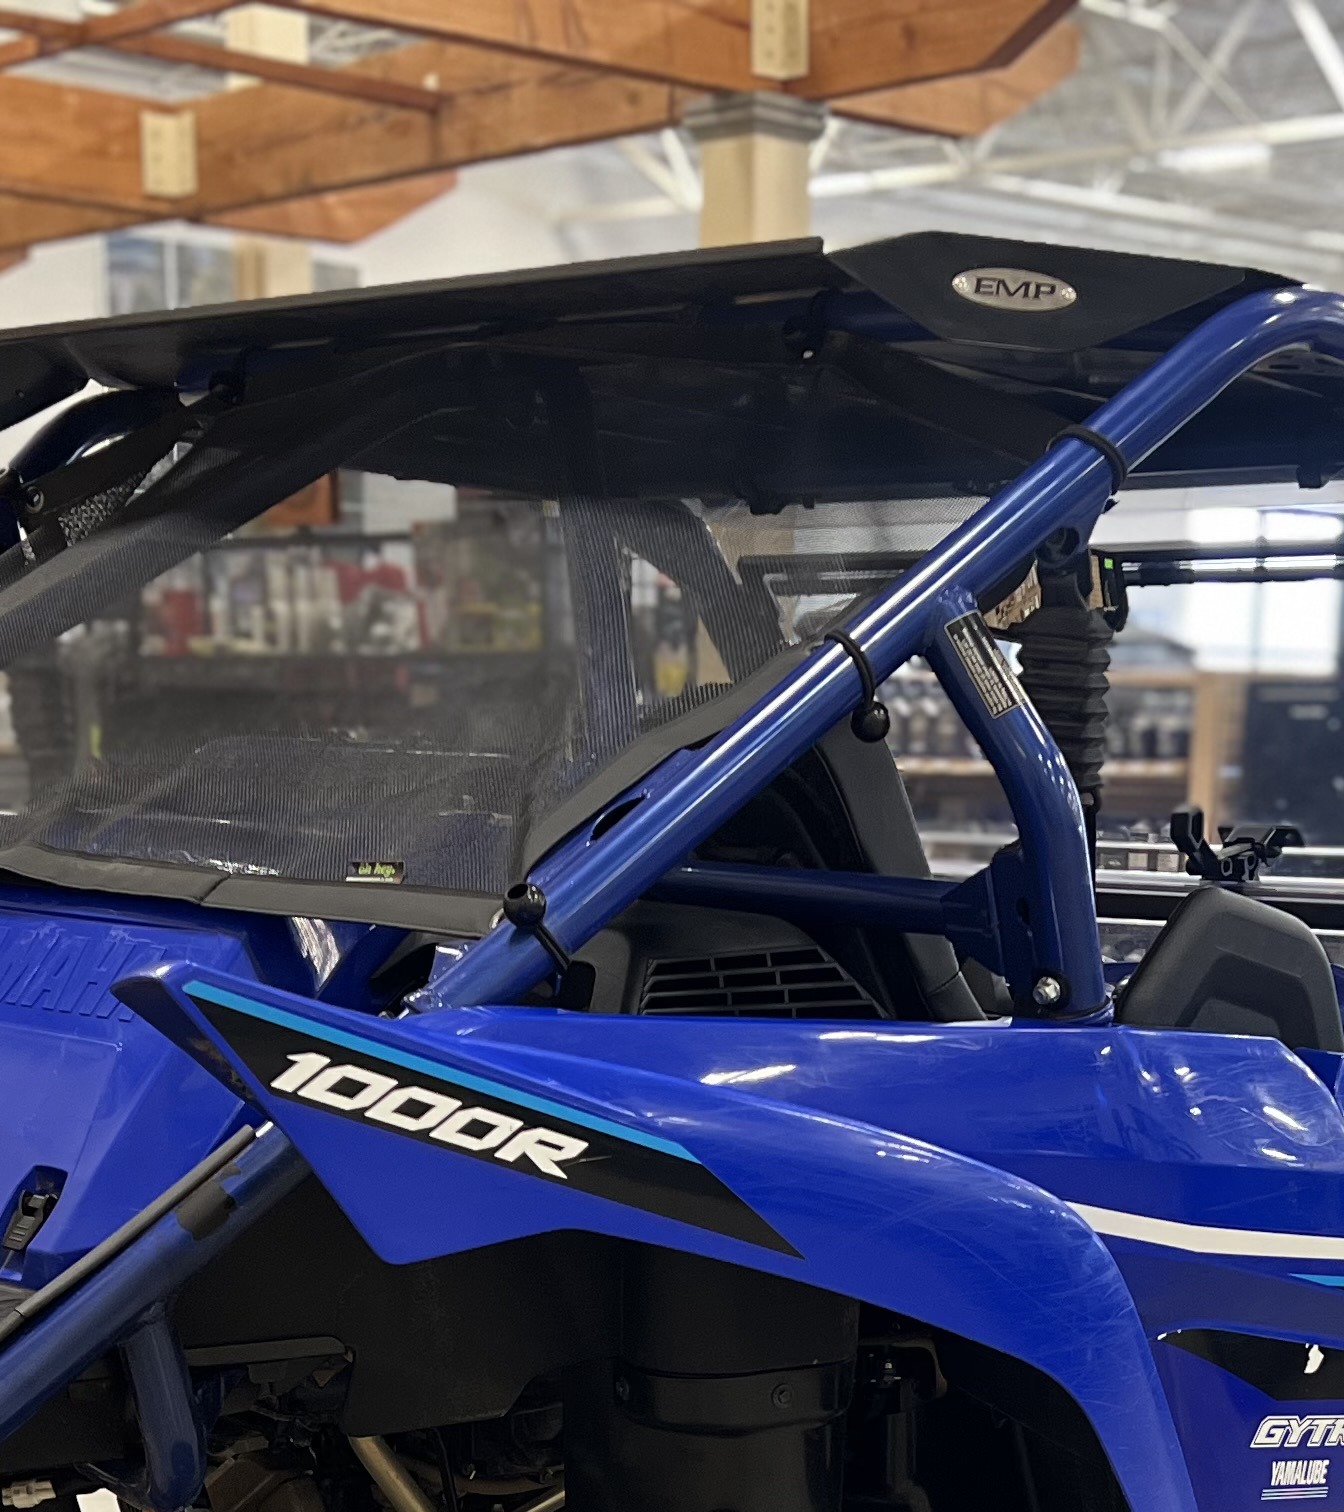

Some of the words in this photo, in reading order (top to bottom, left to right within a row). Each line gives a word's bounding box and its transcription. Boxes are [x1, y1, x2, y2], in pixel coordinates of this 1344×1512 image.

[974, 276, 1056, 301] EMP
[270, 1051, 589, 1179] 1000R
[1270, 1459, 1330, 1486] YAMALUBE
